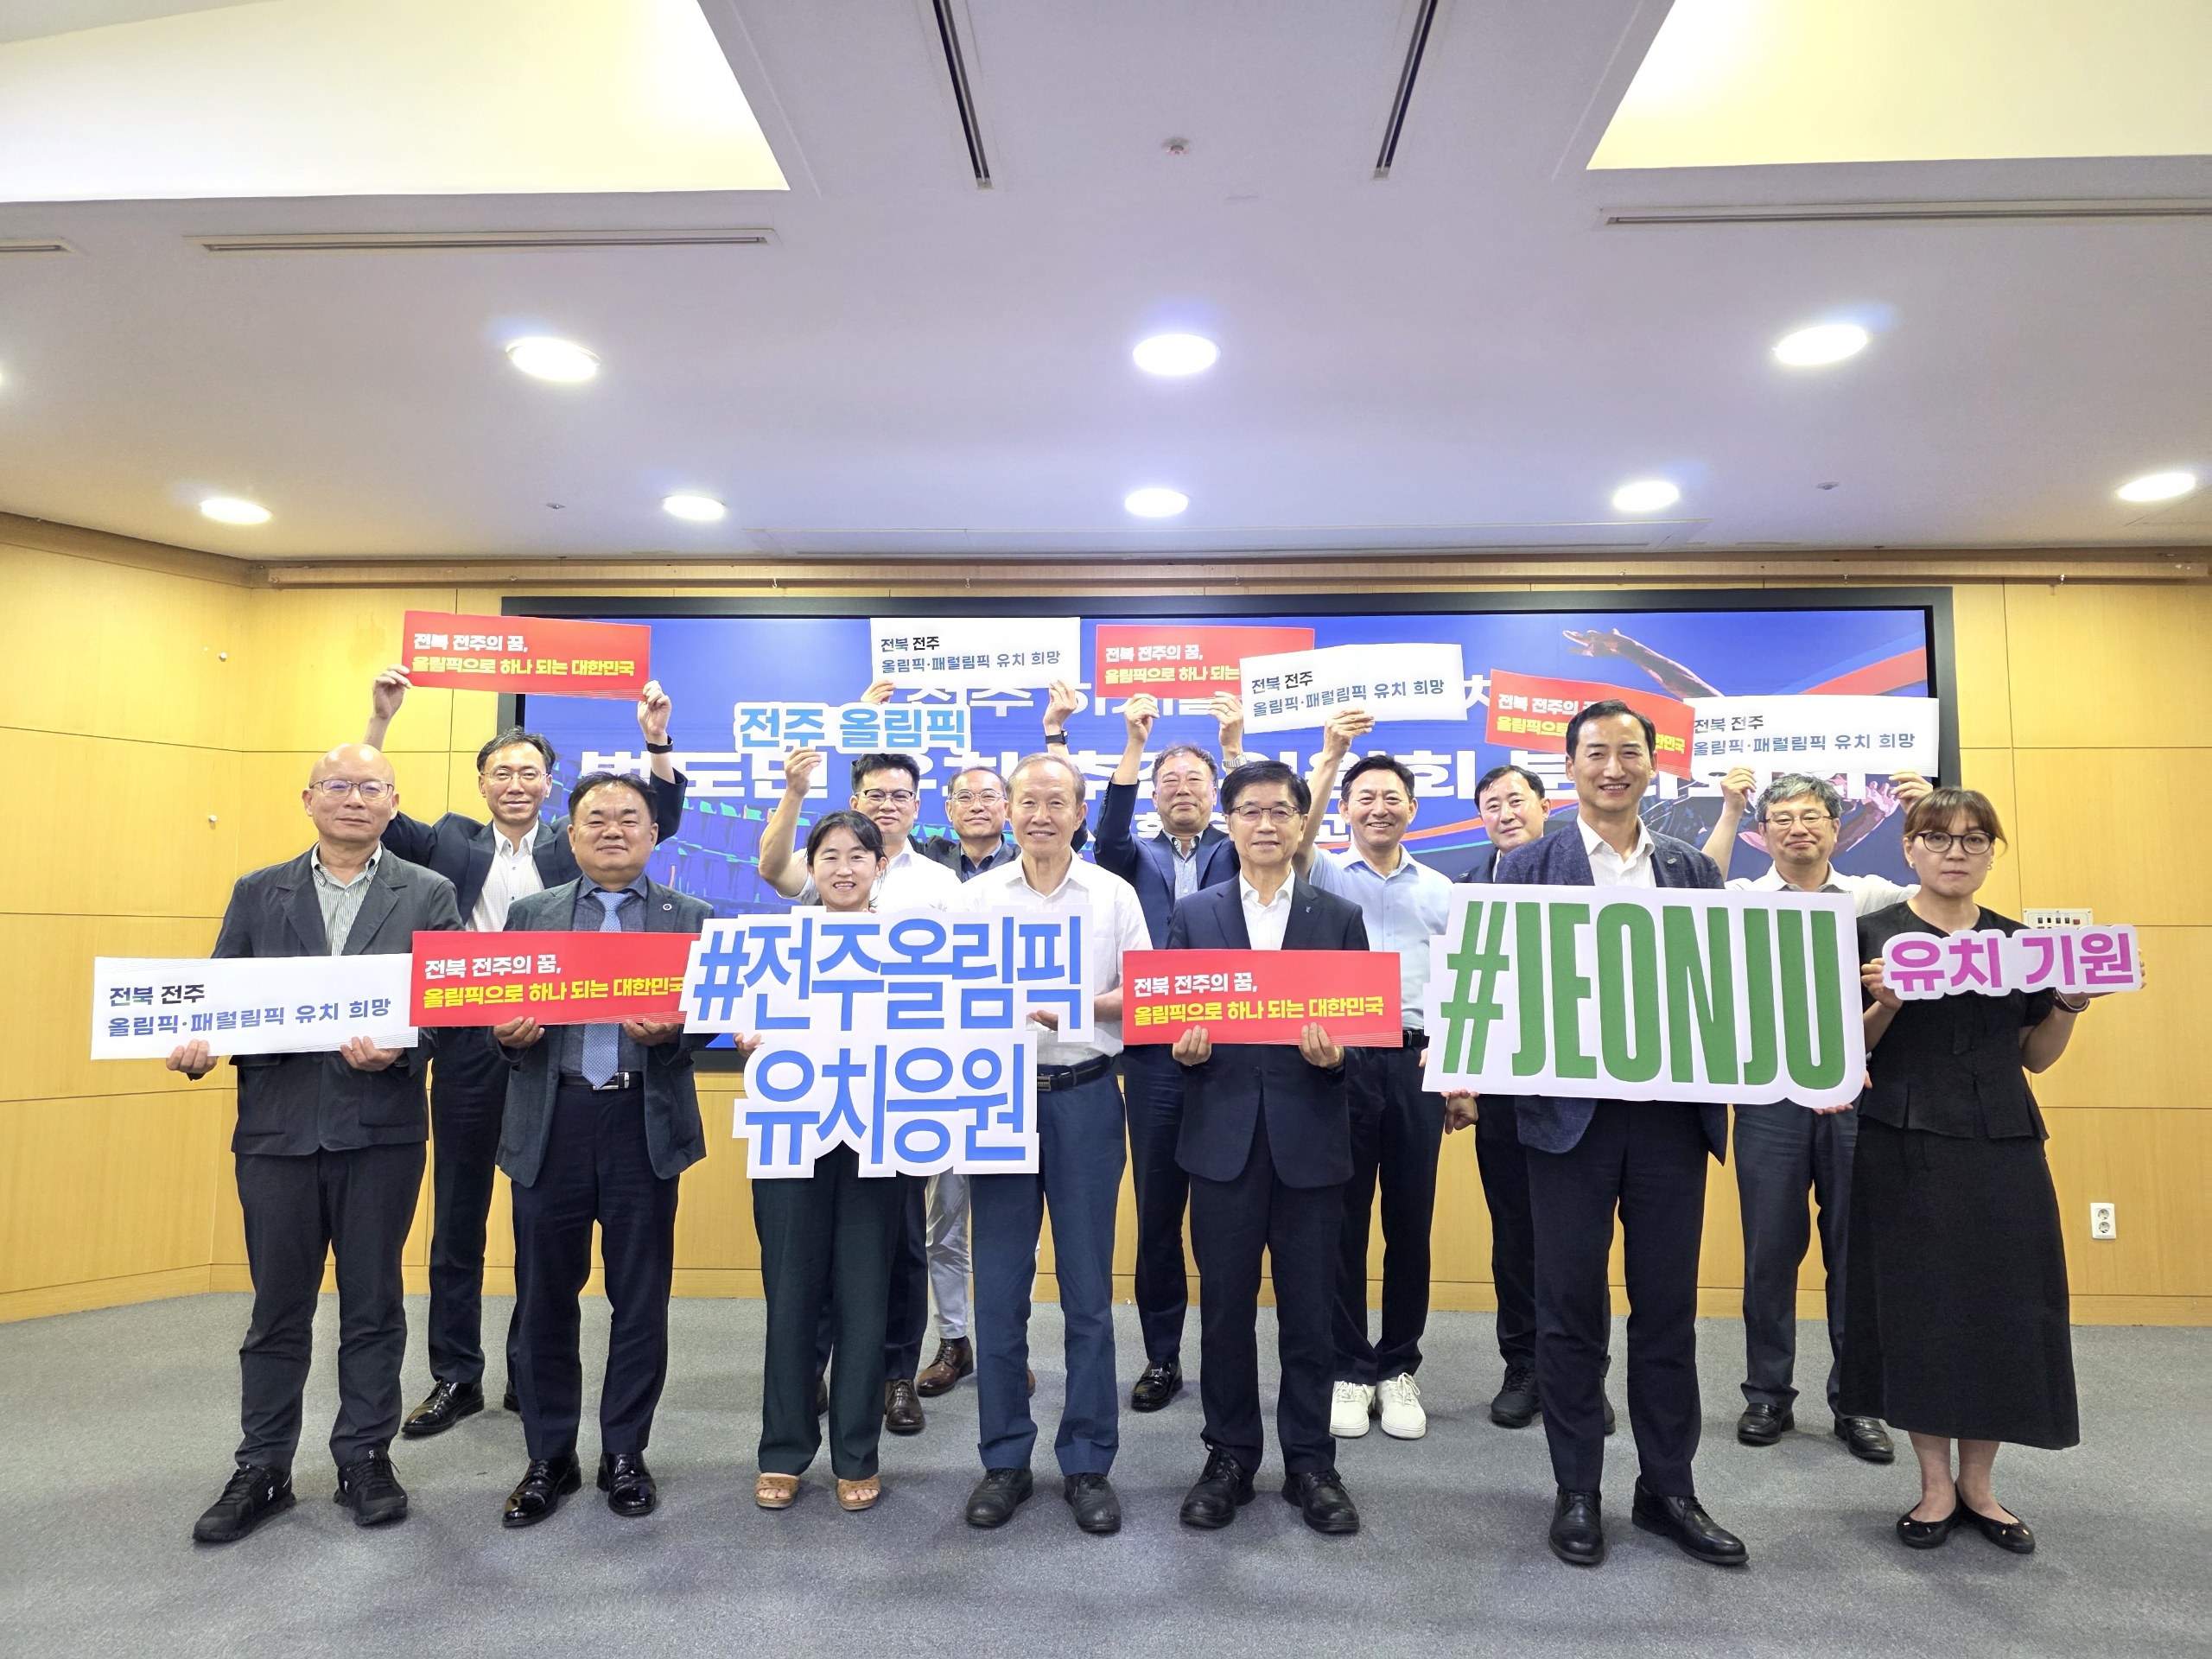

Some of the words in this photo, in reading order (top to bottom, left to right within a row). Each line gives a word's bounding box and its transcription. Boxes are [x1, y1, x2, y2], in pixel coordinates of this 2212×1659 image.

[414, 632, 448, 650] 전북
[453, 634, 502, 651] 전주의
[507, 635, 528, 652] 꿈,
[880, 638, 908, 652] 전북
[912, 636, 939, 651] 전주
[1106, 646, 1134, 662] 전북
[1138, 645, 1181, 662] 전주의
[1185, 645, 1204, 660] 꿈,
[412, 656, 496, 674] 올림픽으로
[500, 659, 532, 675] 하나
[535, 659, 568, 675] 되는
[571, 660, 634, 676] 대한민국
[882, 655, 990, 673] 올림픽·패럴림픽
[997, 652, 1025, 667] 유치
[1031, 651, 1060, 665] 희망
[1105, 667, 1175, 684] 올림픽으로
[1179, 666, 1209, 682] 하나
[1210, 665, 1240, 681] 되는
[1252, 676, 1280, 694] 전북
[1285, 671, 1313, 689] 전주
[1253, 684, 1366, 717] 올림픽·패럴림픽
[1374, 681, 1407, 699] 유치
[1414, 679, 1445, 695] 희망
[1498, 693, 1529, 712] 전북
[1531, 697, 1579, 715] 전주의
[740, 708, 824, 748] 전주
[840, 709, 964, 748] 올림픽
[1694, 717, 1726, 734] 전북
[1731, 715, 1764, 731] 전주
[1834, 734, 1870, 749] 유치
[1878, 733, 1915, 748] 희망
[425, 959, 467, 979] 전북
[472, 955, 531, 977] 전주의
[537, 954, 562, 975] 꿈,
[693, 916, 1080, 1031] #전주올림픽
[1891, 938, 2002, 992] 유치
[2022, 932, 2133, 985] 기원
[109, 987, 153, 1007] 전북
[161, 984, 205, 1005] 전주
[423, 984, 523, 1008] 올림픽으로
[529, 982, 567, 1002] 하나
[570, 979, 608, 999] 되는
[613, 977, 685, 997] 대한민국
[1135, 976, 1169, 998] 전북
[1174, 974, 1228, 995] 전주의
[1234, 972, 1257, 993] 꿈,
[1440, 900, 1845, 1090] #JEONJU
[108, 1007, 284, 1037] 올림픽·패럴림픽
[296, 1002, 339, 1024] 유치
[349, 998, 391, 1019] 희망
[1135, 1002, 1222, 1026] 올림픽으로
[1227, 1001, 1263, 1020] 하나
[1267, 999, 1304, 1018] 되는
[1309, 996, 1383, 1017] 대한민국
[746, 1043, 1026, 1165] 유치응원
